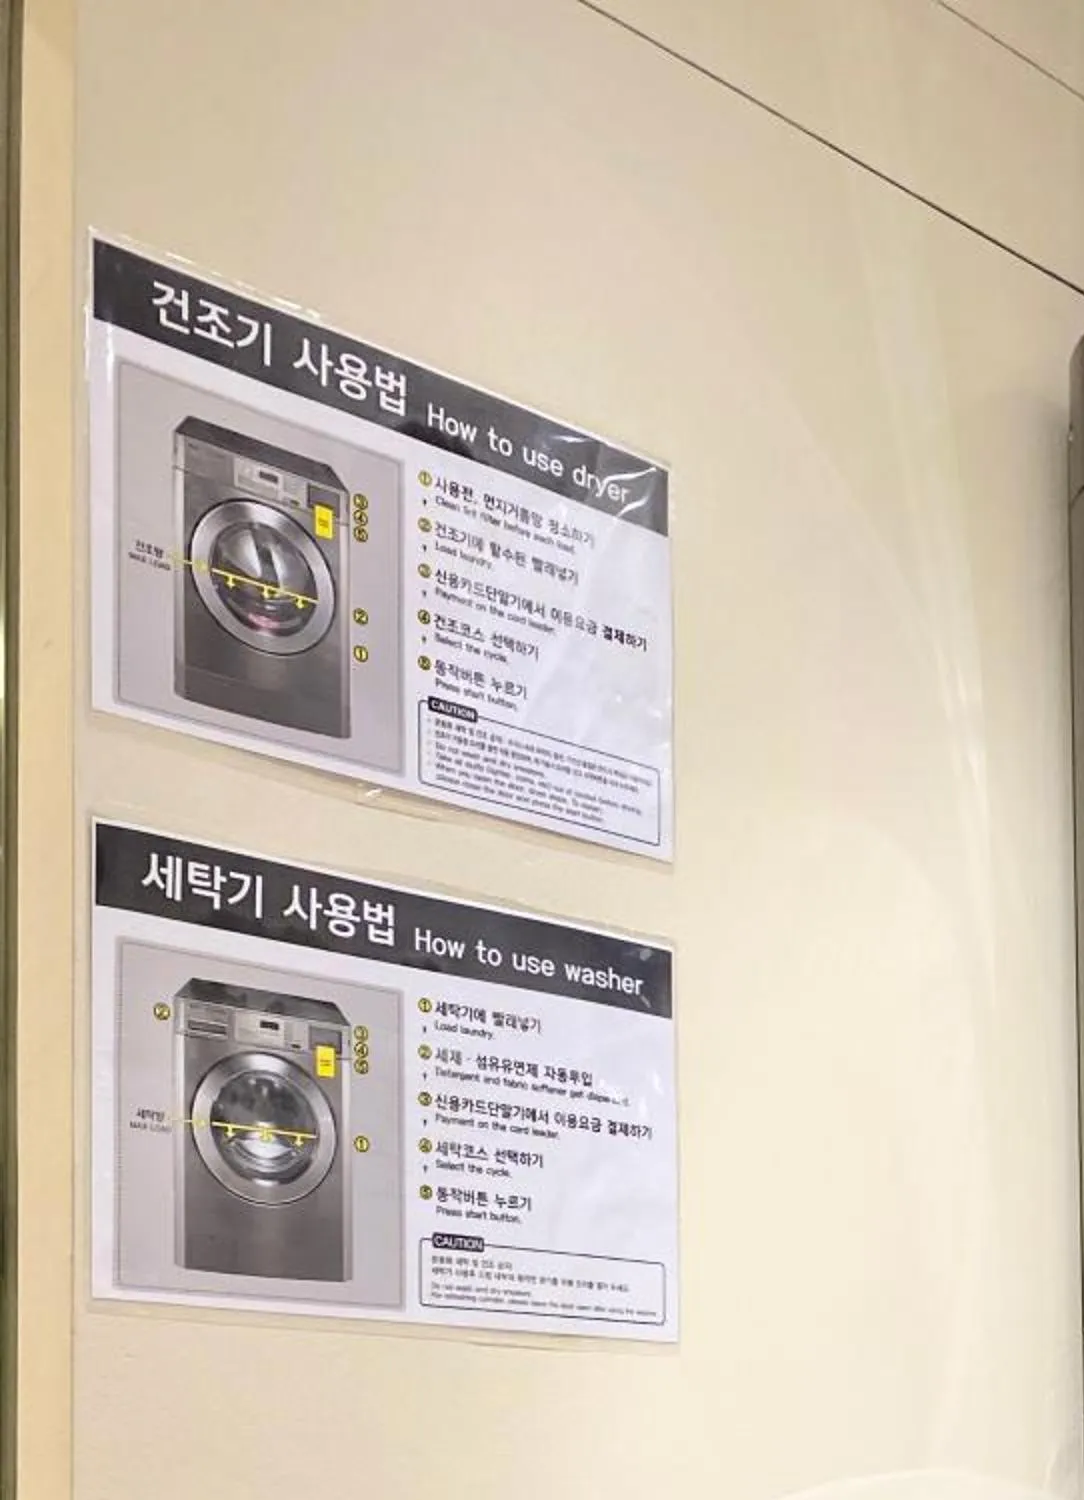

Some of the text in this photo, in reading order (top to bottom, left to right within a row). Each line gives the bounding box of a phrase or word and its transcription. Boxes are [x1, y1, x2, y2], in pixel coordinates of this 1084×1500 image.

[152, 280, 630, 504] 건조기 사용법 How to use dryer
[434, 521, 484, 552] 건조기에
[434, 568, 546, 619] 신용카드단말기에서
[550, 606, 598, 636] 이용요금
[601, 623, 648, 652] 결제하기
[434, 613, 485, 643] 건조코스
[490, 631, 540, 662] 선택하기
[434, 658, 485, 689] 동작버튼
[491, 677, 528, 701] 누르기
[431, 699, 476, 720] CAUTION
[142, 851, 645, 996] 세탁기 사용법 How to use washer
[435, 1001, 486, 1025] 세탁기에
[492, 1011, 542, 1034] 빨래넣기
[475, 1054, 539, 1079] 섬유유연제
[543, 1064, 593, 1087] 자동투입
[435, 1095, 550, 1126] 신용카드단말기에서
[554, 1111, 602, 1133] 이용요금
[607, 1119, 653, 1141] 결제하기
[436, 1141, 489, 1161] 세탁코스
[494, 1149, 544, 1169] 선택하기
[436, 1186, 489, 1207] 동작버튼
[494, 1193, 532, 1212] 누르기
[433, 1235, 483, 1250] CAUTION
